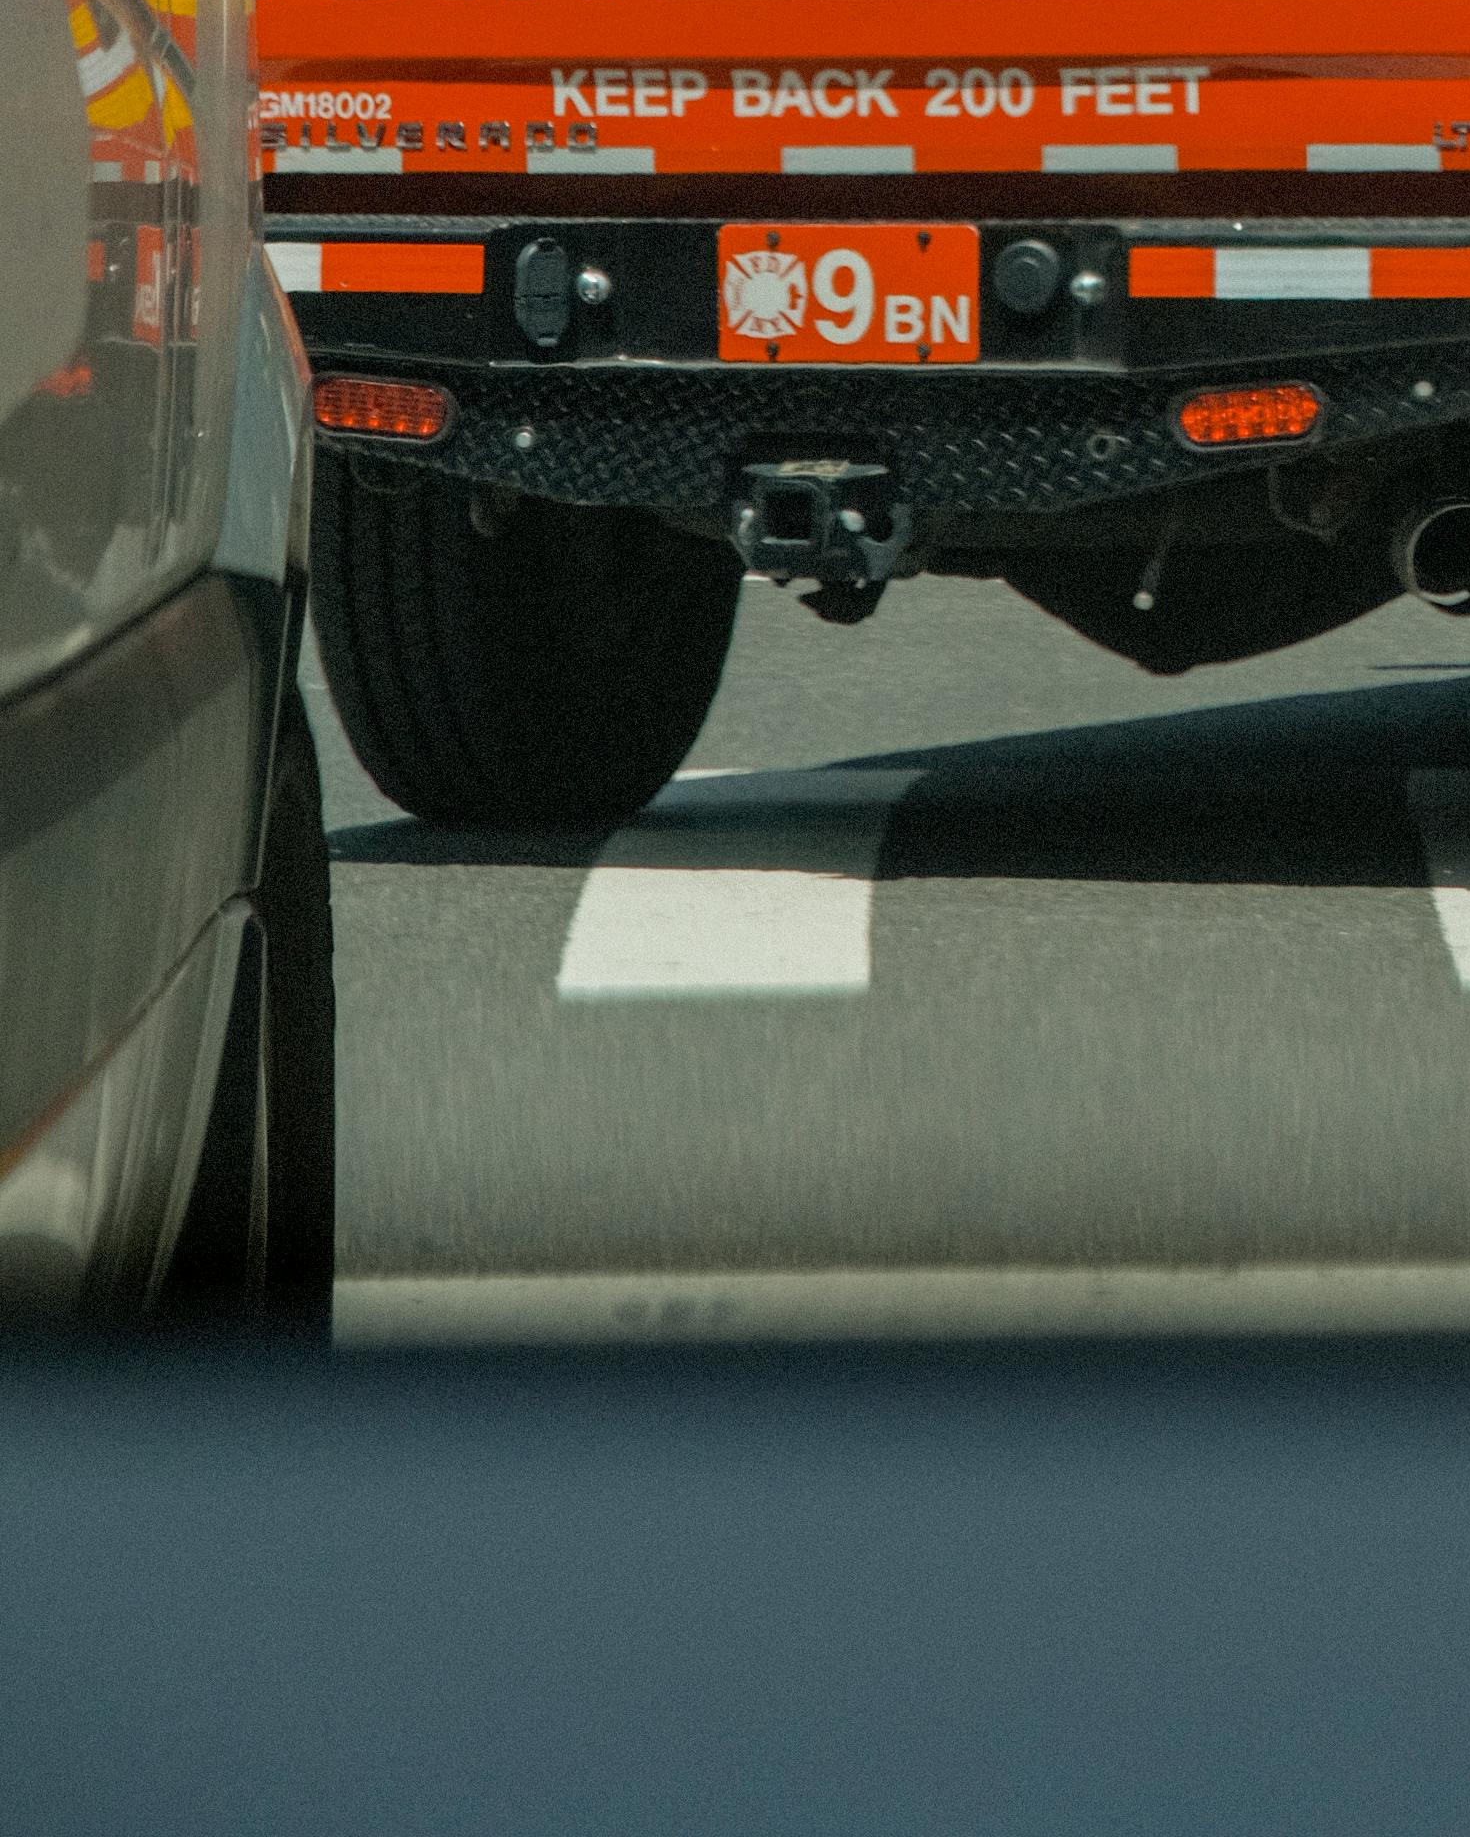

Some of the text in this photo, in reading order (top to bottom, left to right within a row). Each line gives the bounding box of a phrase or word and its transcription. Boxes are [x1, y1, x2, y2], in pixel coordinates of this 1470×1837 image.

[551, 65, 1211, 118] KEEP BACK 200 FEET
[260, 121, 598, 153] SILVERADO
[811, 247, 971, 346] 9 BN
